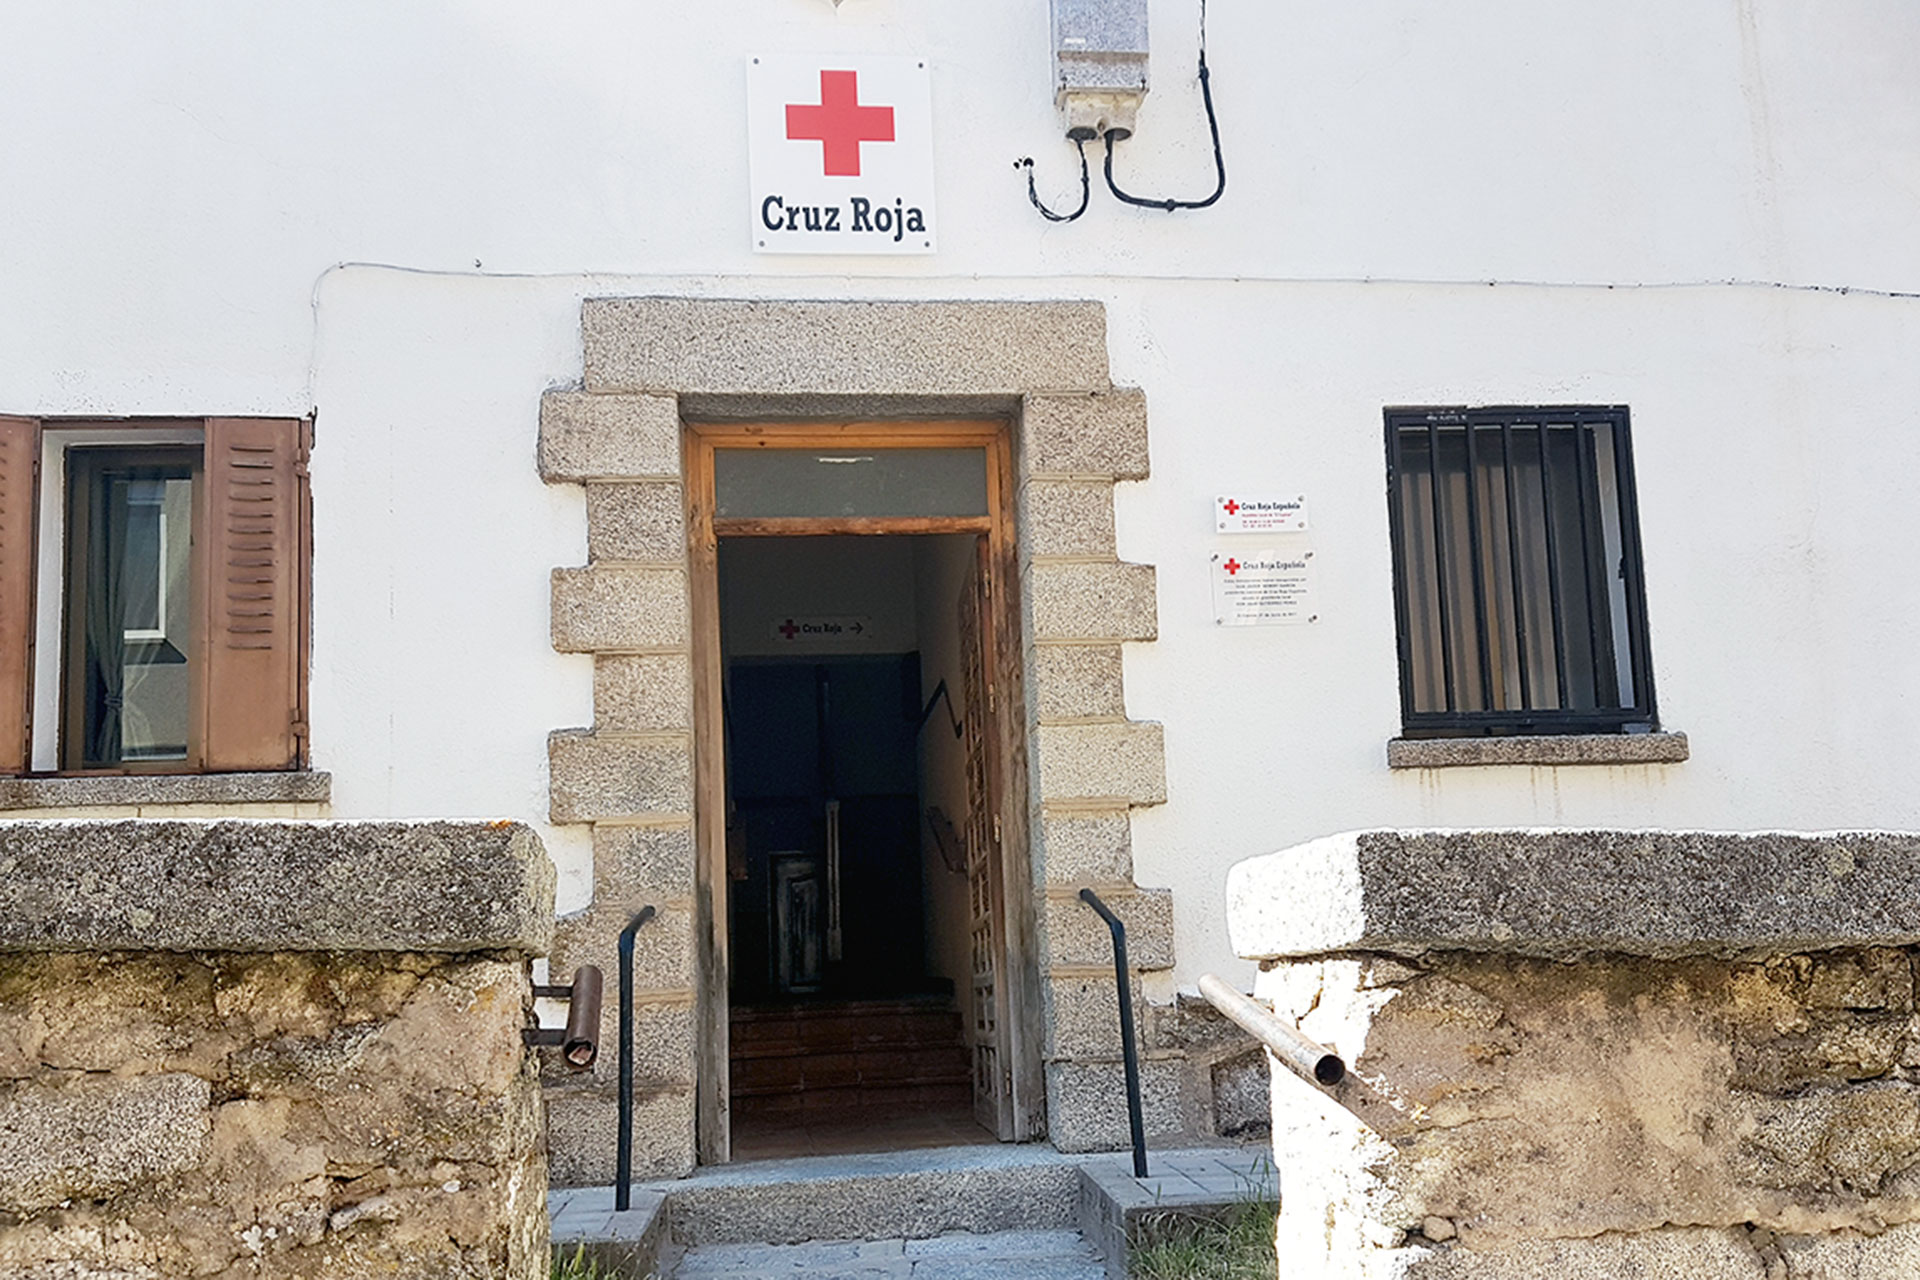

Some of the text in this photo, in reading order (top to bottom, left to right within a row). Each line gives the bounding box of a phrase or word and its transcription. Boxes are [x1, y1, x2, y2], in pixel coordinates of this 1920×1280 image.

[762, 195, 926, 243] Cruz Roja
[802, 622, 842, 635] Cruz Roja
